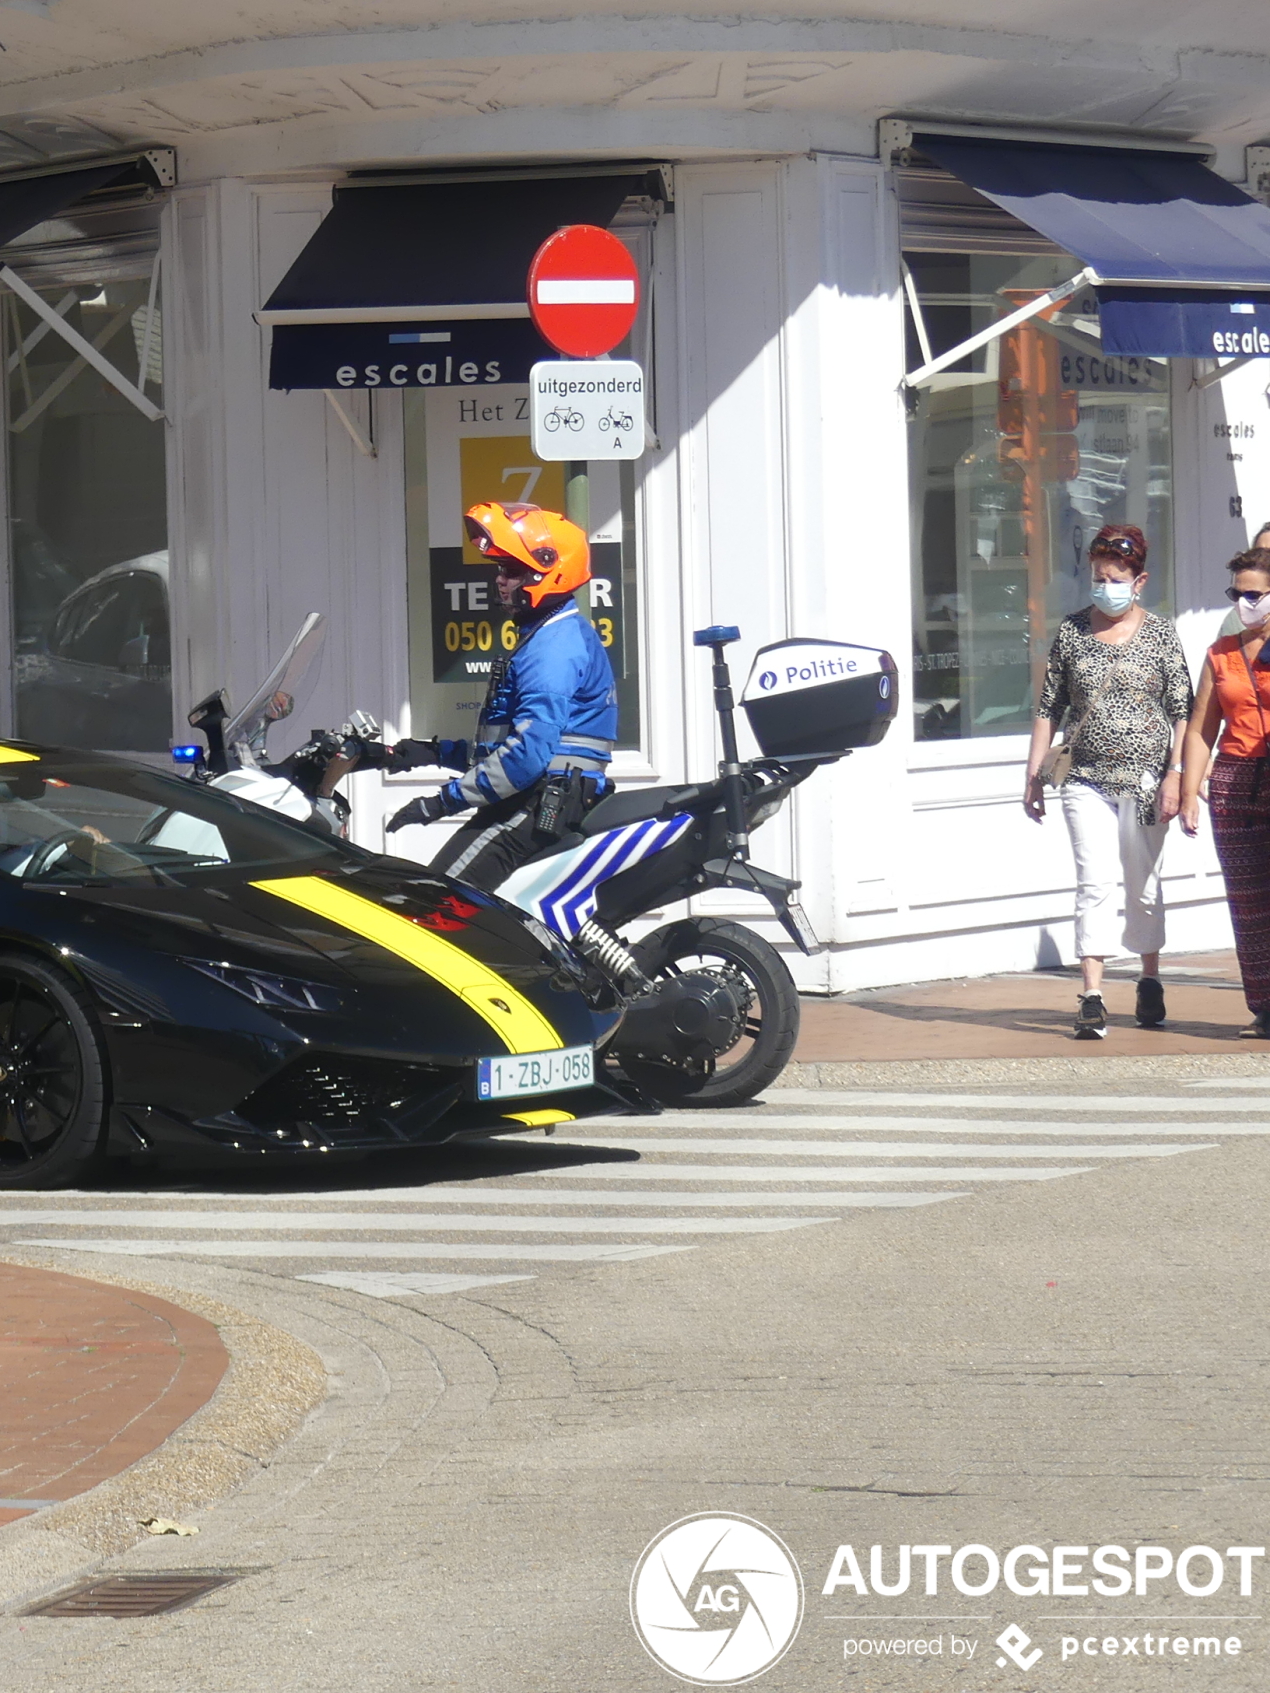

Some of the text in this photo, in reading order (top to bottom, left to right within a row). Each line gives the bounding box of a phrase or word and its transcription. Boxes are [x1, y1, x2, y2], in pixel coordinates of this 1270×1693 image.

[335, 356, 502, 387] escales
[1061, 355, 1152, 385] escales
[537, 377, 643, 397] uitgezonderd
[459, 398, 505, 423] Het
[1213, 421, 1255, 439] escales
[613, 437, 623, 449] A
[1229, 495, 1243, 519] 63
[444, 582, 489, 611] TE
[445, 622, 493, 652] 050
[786, 657, 858, 684] Politie
[481, 1082, 490, 1095] B
